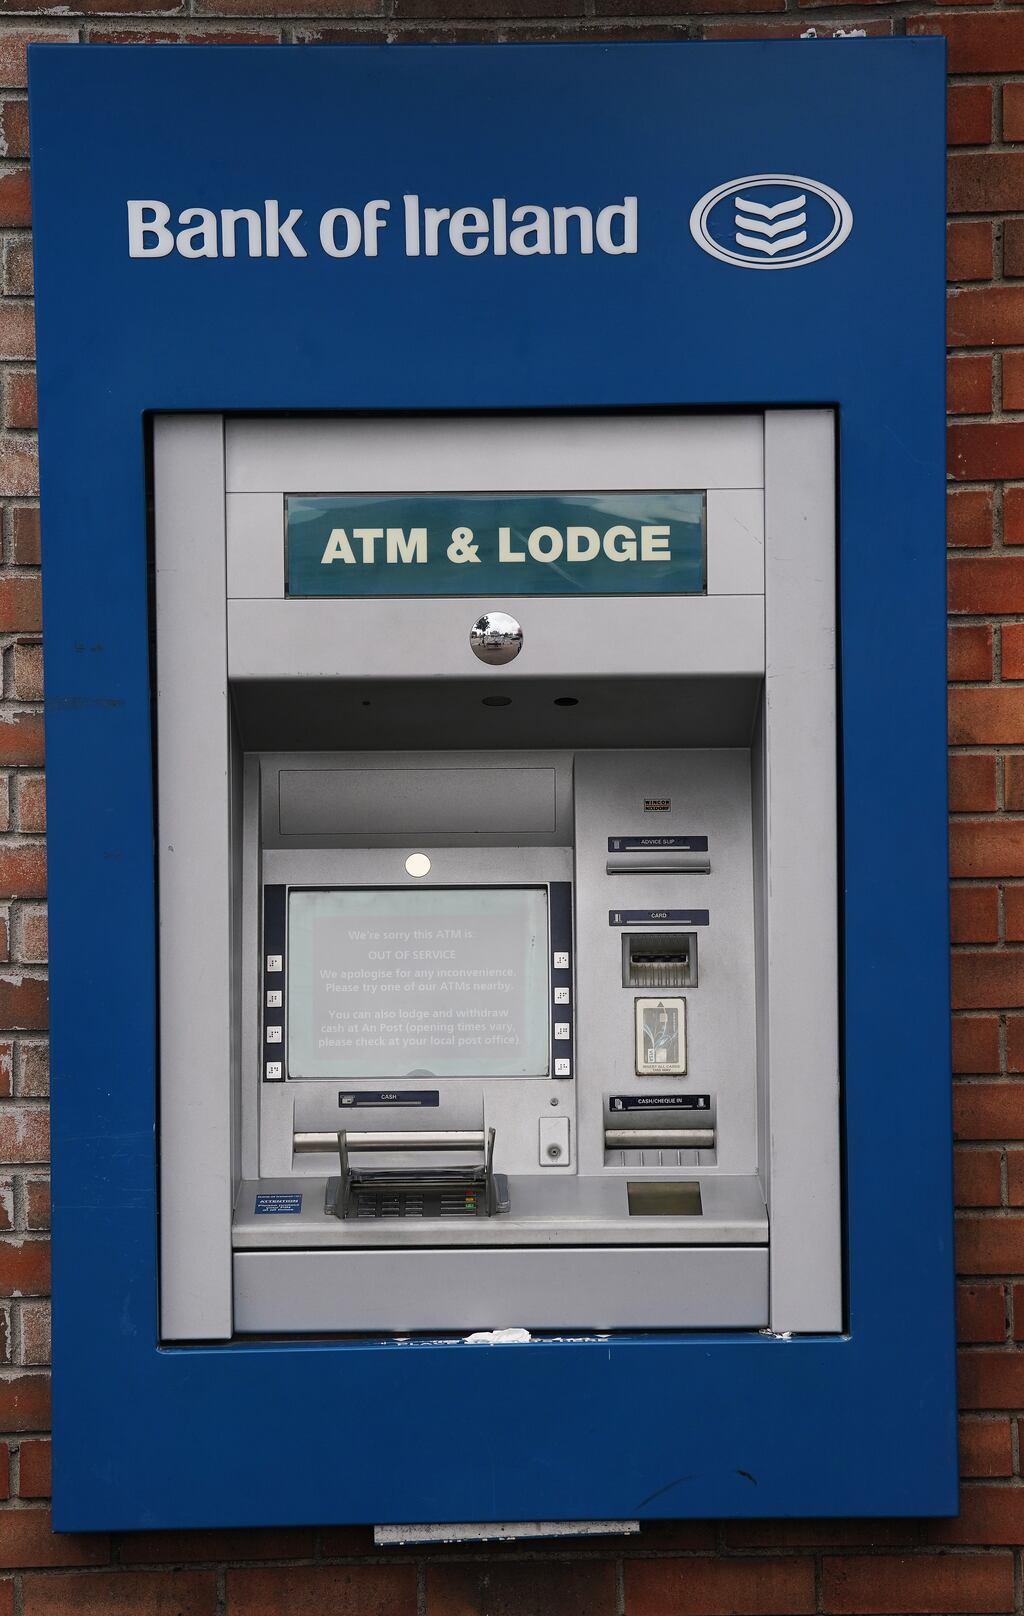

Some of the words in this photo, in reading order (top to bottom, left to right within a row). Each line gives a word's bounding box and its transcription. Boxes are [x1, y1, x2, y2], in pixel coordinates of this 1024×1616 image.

[127, 199, 307, 259] Bank
[319, 198, 390, 259] of
[403, 193, 640, 257] Ireland
[321, 528, 427, 564] ATM
[447, 527, 481, 564] &
[498, 525, 671, 563] LODGE
[348, 930, 380, 940] We're
[383, 931, 410, 942] sorry
[414, 930, 433, 939] this
[436, 929, 462, 939] ATM
[464, 929, 473, 938] is
[368, 950, 392, 960] OUT
[395, 950, 410, 960] OF
[413, 950, 457, 960] SERVICE
[319, 969, 338, 979] We
[341, 968, 393, 981] apologise
[395, 968, 411, 978] for
[414, 969, 434, 981] any
[437, 968, 517, 977] inconvenience.
[326, 982, 360, 992] Please
[363, 983, 376, 994] try
[380, 984, 401, 992] one
[404, 982, 416, 992] of
[419, 984, 437, 992] our
[440, 982, 471, 992] ATMs
[473, 981, 514, 993] nearby.
[328, 1010, 350, 1019] You
[353, 1011, 371, 1019] can
[374, 1009, 396, 1019] also
[399, 1009, 430, 1020] lodge
[433, 1008, 453, 1018] and
[456, 1008, 509, 1018] withdraw
[321, 1024, 344, 1033] cash
[347, 1024, 359, 1033] at
[361, 1024, 377, 1032] An
[380, 1023, 402, 1032] Post
[405, 1023, 454, 1035] (opening
[457, 1023, 487, 1032] times
[318, 1038, 353, 1049] please
[355, 1036, 386, 1046] check
[388, 1037, 399, 1046] at
[402, 1037, 427, 1048] your
[430, 1036, 455, 1045] local
[458, 1036, 482, 1047] post
